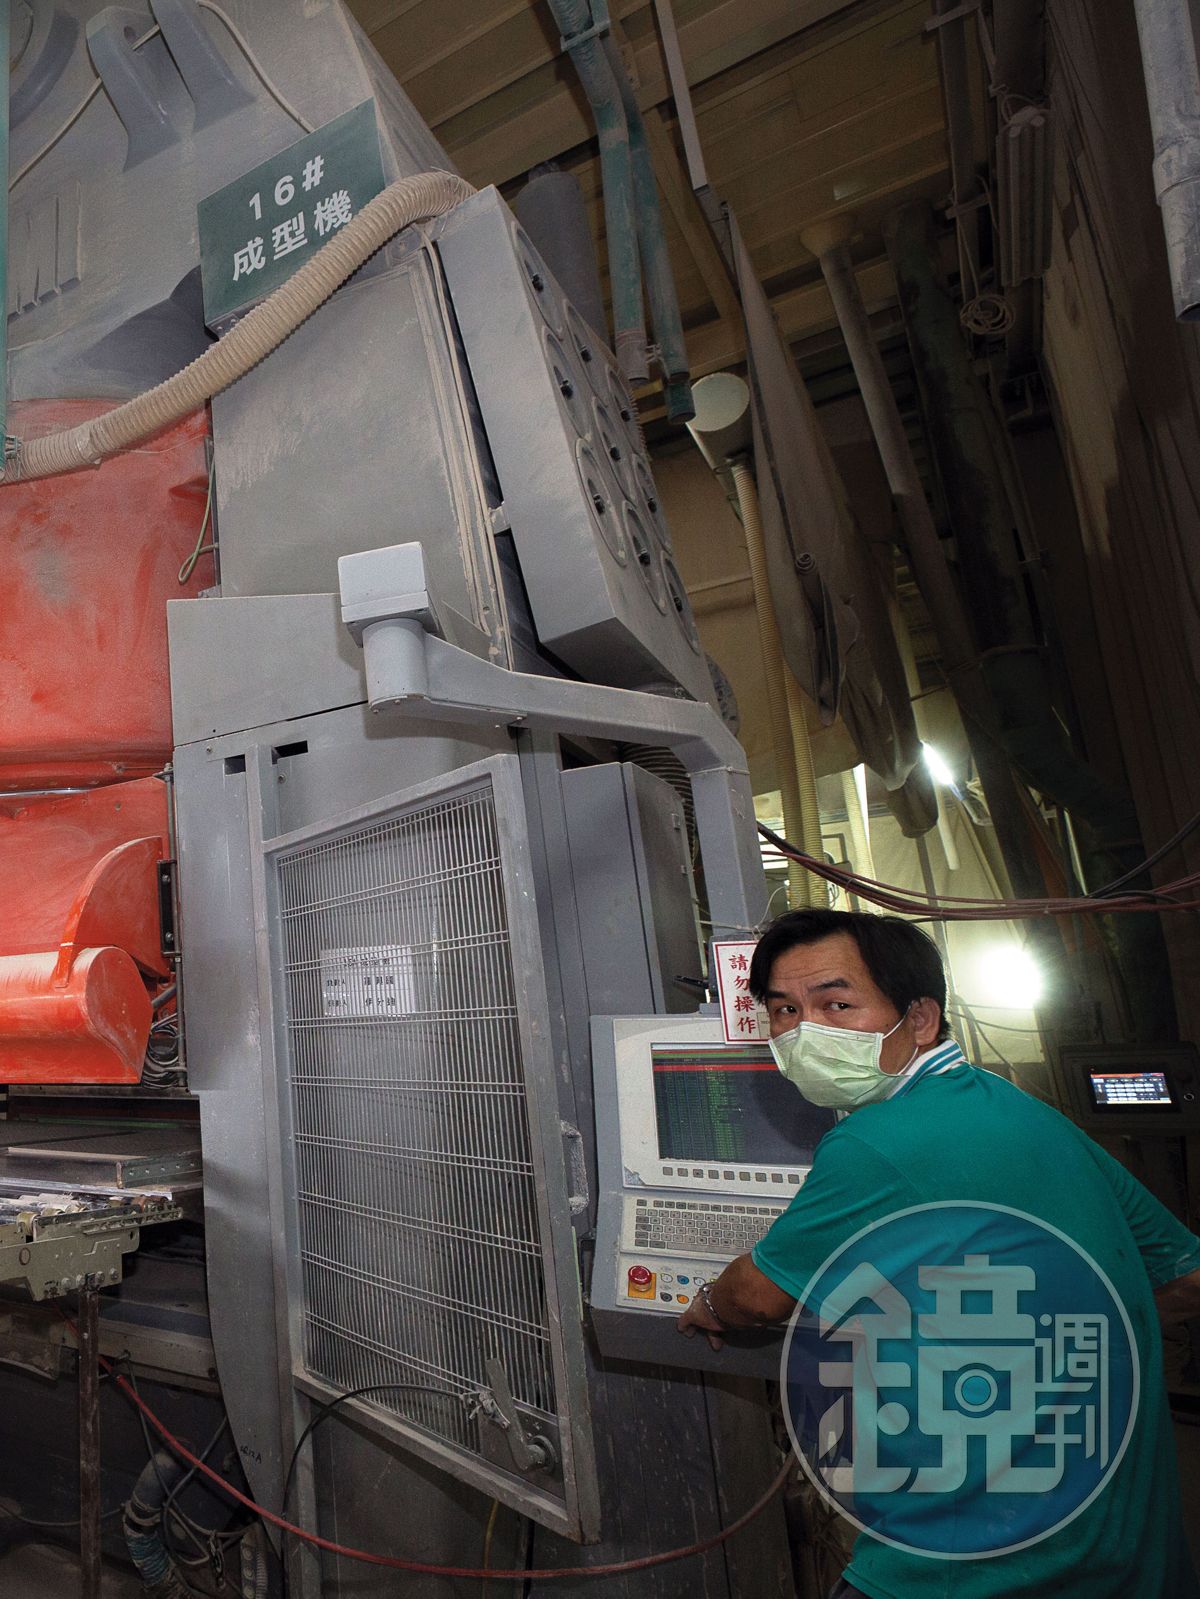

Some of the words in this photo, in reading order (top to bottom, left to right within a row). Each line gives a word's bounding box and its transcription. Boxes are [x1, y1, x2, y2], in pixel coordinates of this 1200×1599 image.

[248, 154, 325, 221] 16#
[232, 189, 353, 281] 成型機
[728, 953, 757, 1034] 請勿操作
